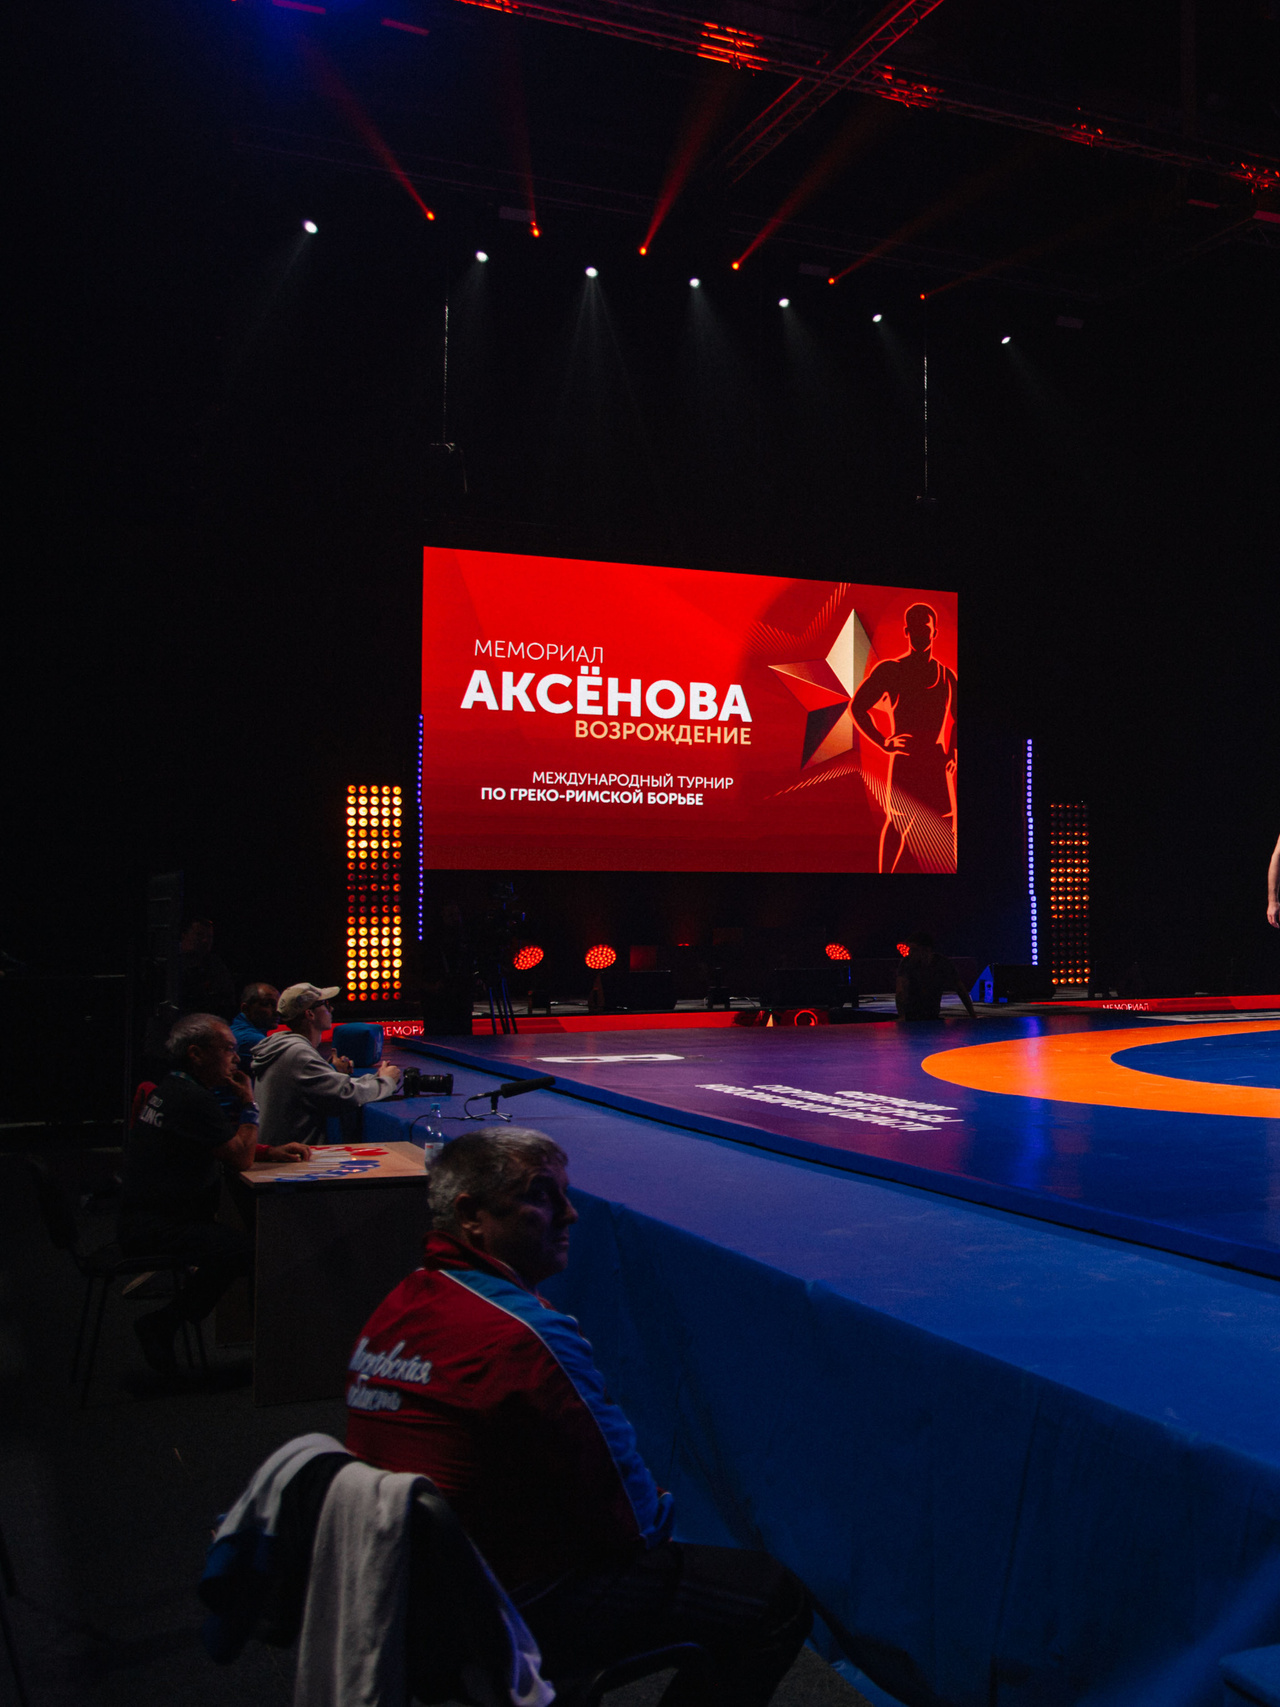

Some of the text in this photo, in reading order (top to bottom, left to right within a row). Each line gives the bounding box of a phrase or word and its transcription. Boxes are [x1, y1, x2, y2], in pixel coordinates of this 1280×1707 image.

[474, 639, 604, 664] МЕМОРИАЛ
[460, 665, 753, 723] АКСЁНОВА
[575, 720, 752, 745] ВОЗРОЖДЕНИЕ
[532, 771, 734, 790] МЕЖДУНАРОДНЫЙ ТУРНИР
[481, 787, 704, 806] ПО ГРЕКО-РИМСКОЙ БОРЬБЕ
